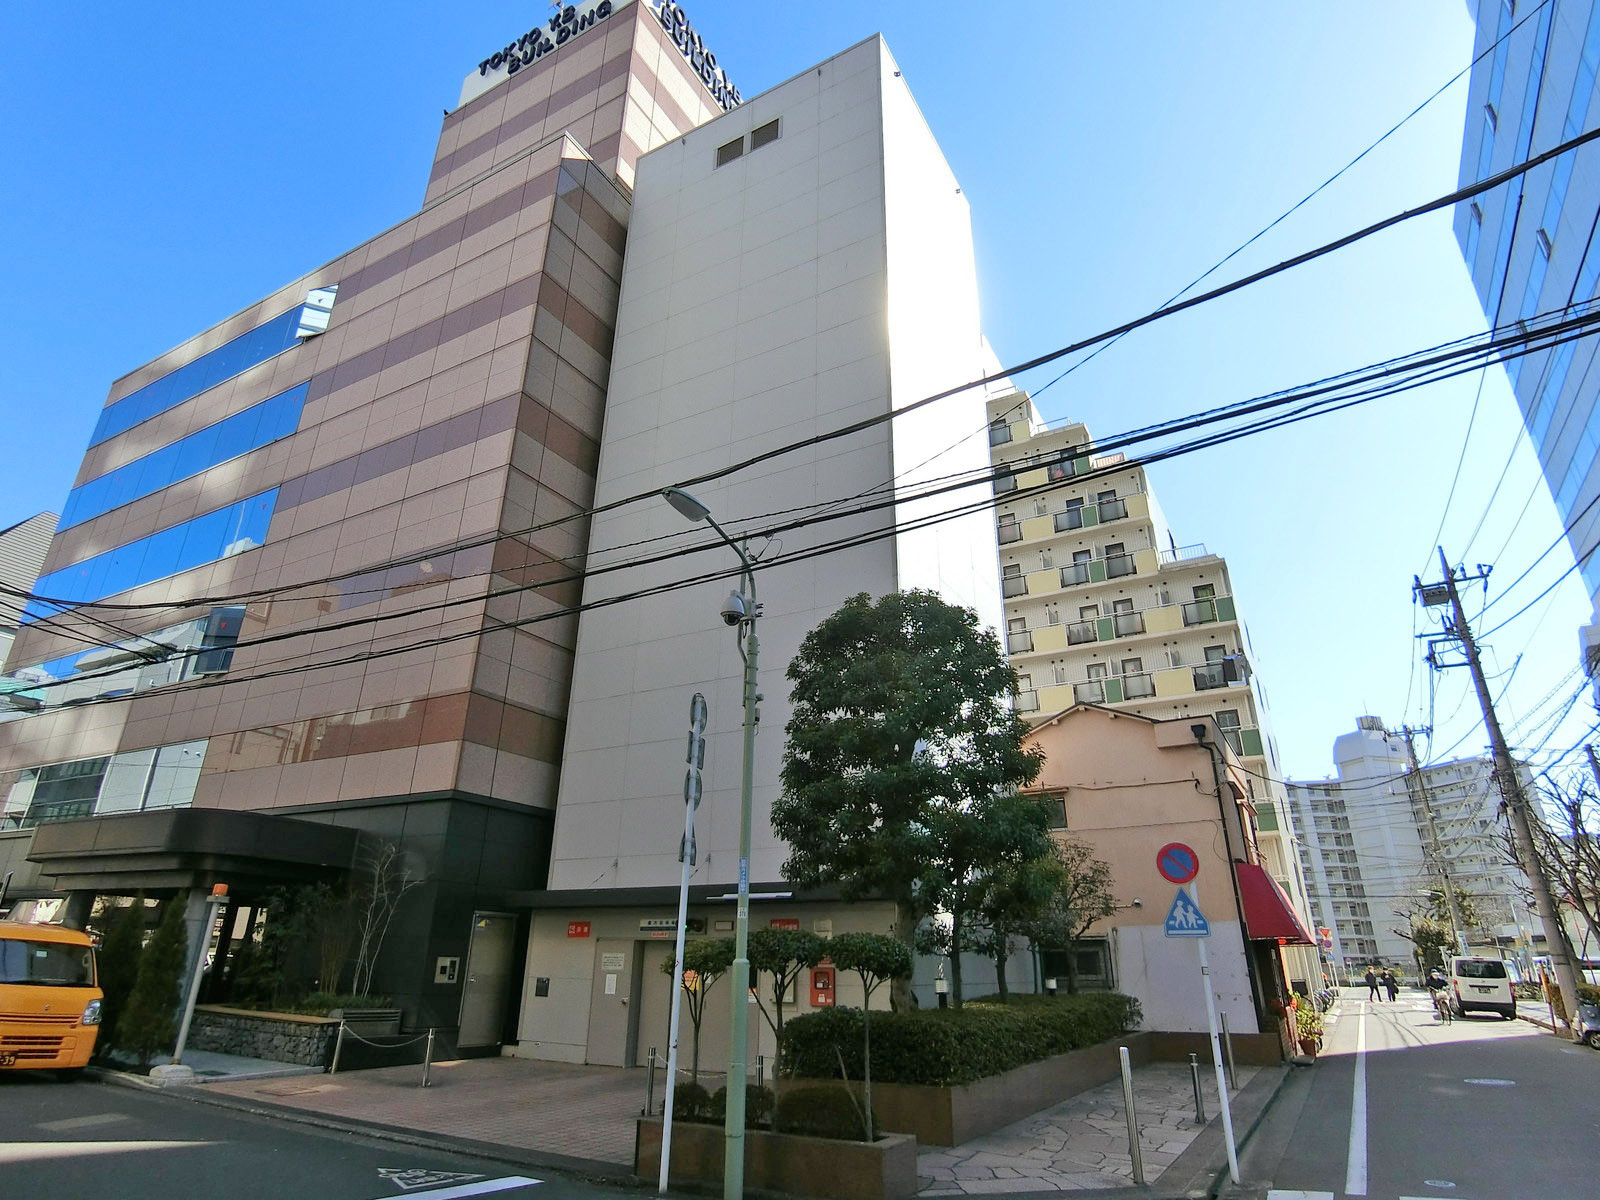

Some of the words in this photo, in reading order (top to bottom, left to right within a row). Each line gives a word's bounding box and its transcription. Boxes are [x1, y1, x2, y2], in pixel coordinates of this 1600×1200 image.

[479, 27, 542, 76] TOKYO
[548, 5, 576, 32] KB
[508, 0, 612, 75] BUILDING
